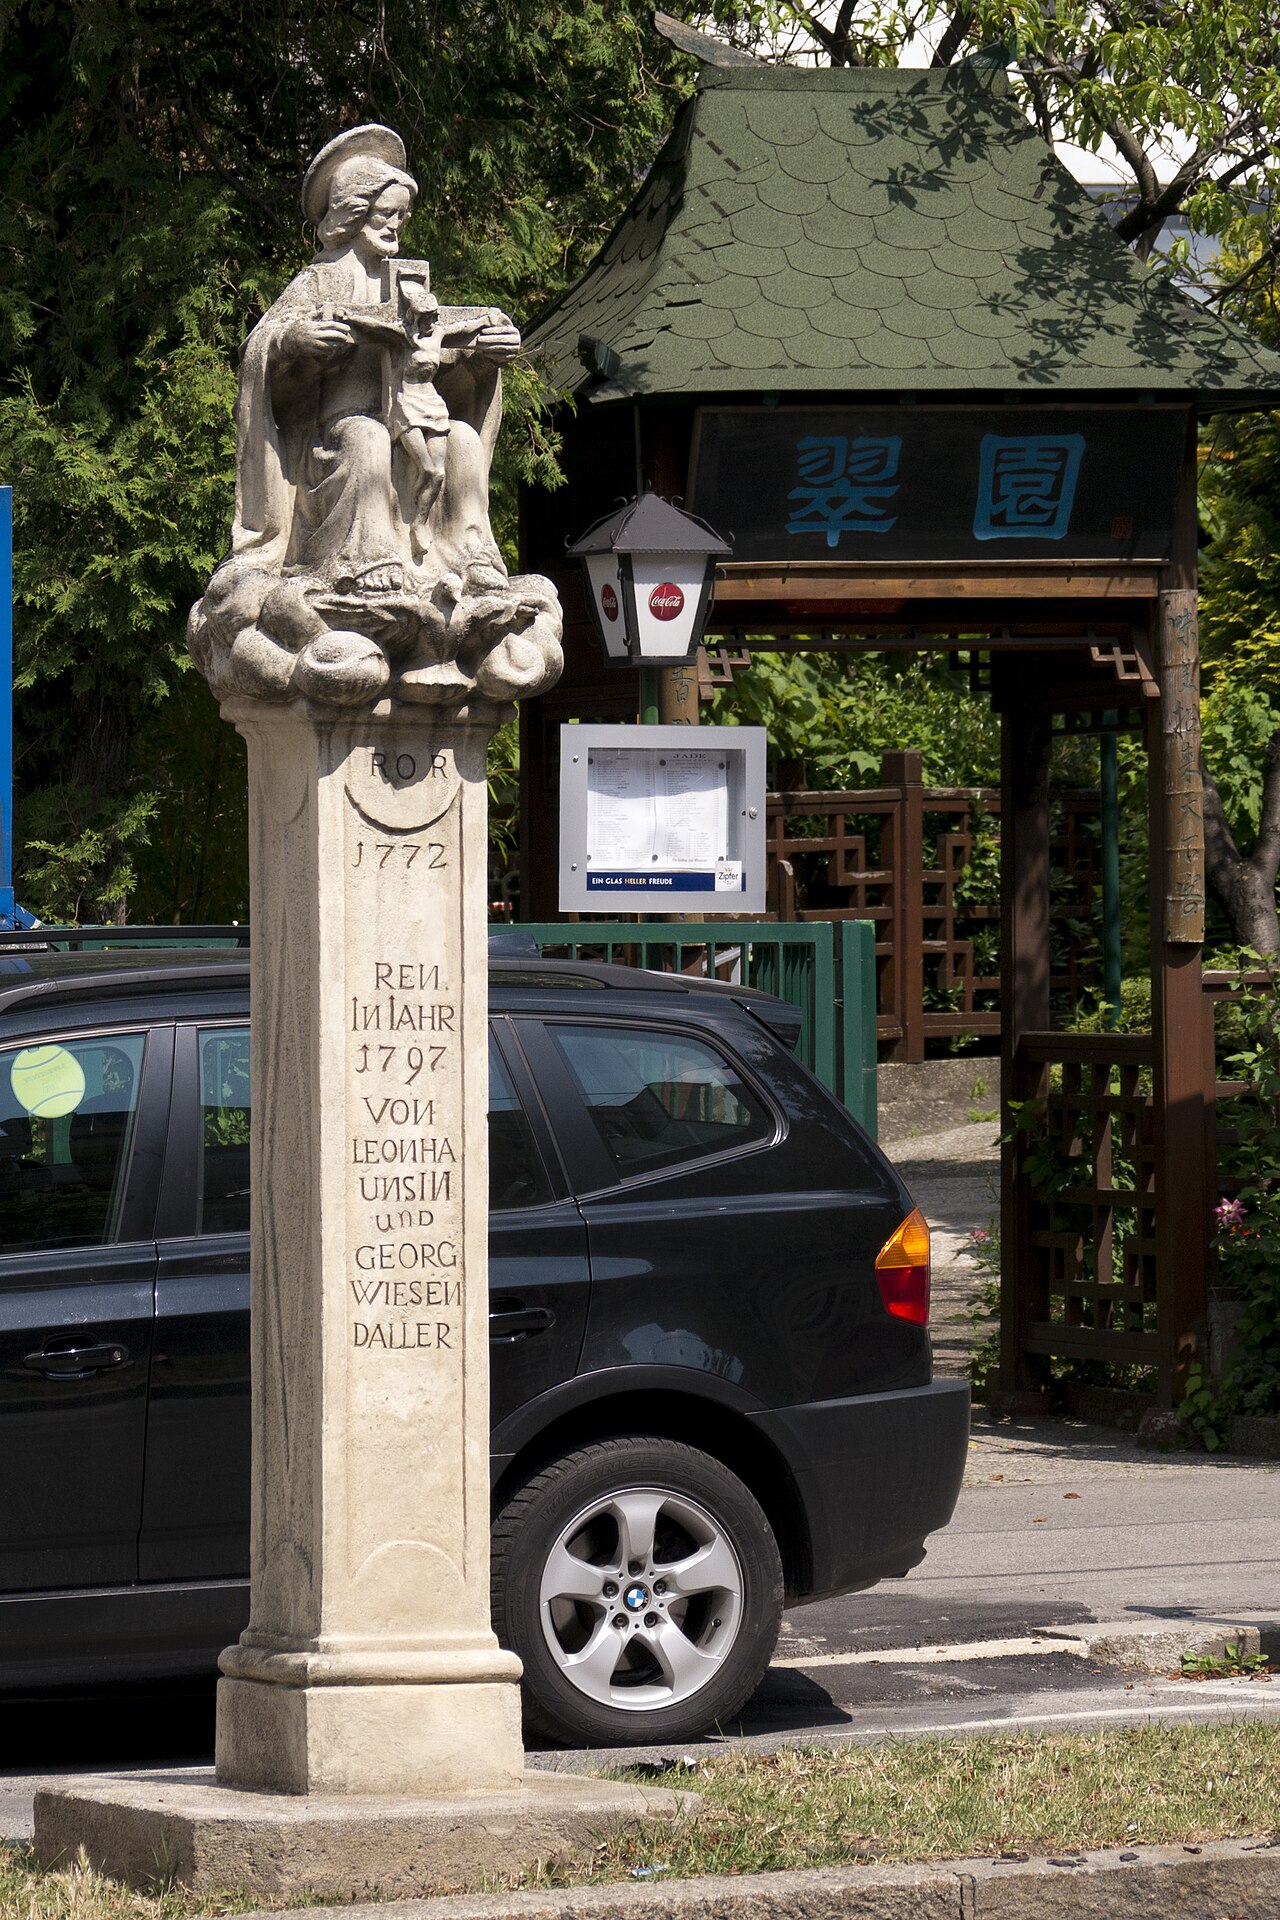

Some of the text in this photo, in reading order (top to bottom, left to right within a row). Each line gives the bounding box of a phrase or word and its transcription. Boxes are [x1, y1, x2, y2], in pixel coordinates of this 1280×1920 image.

[718, 871, 739, 881] Zipfer
[361, 1096, 435, 1126] VON
[351, 1137, 457, 1165] LEONHA
[359, 1170, 451, 1202] UNSIN
[354, 1240, 458, 1271] GEORG
[350, 1279, 462, 1307] WIESEN
[353, 1322, 454, 1350] DALLER
